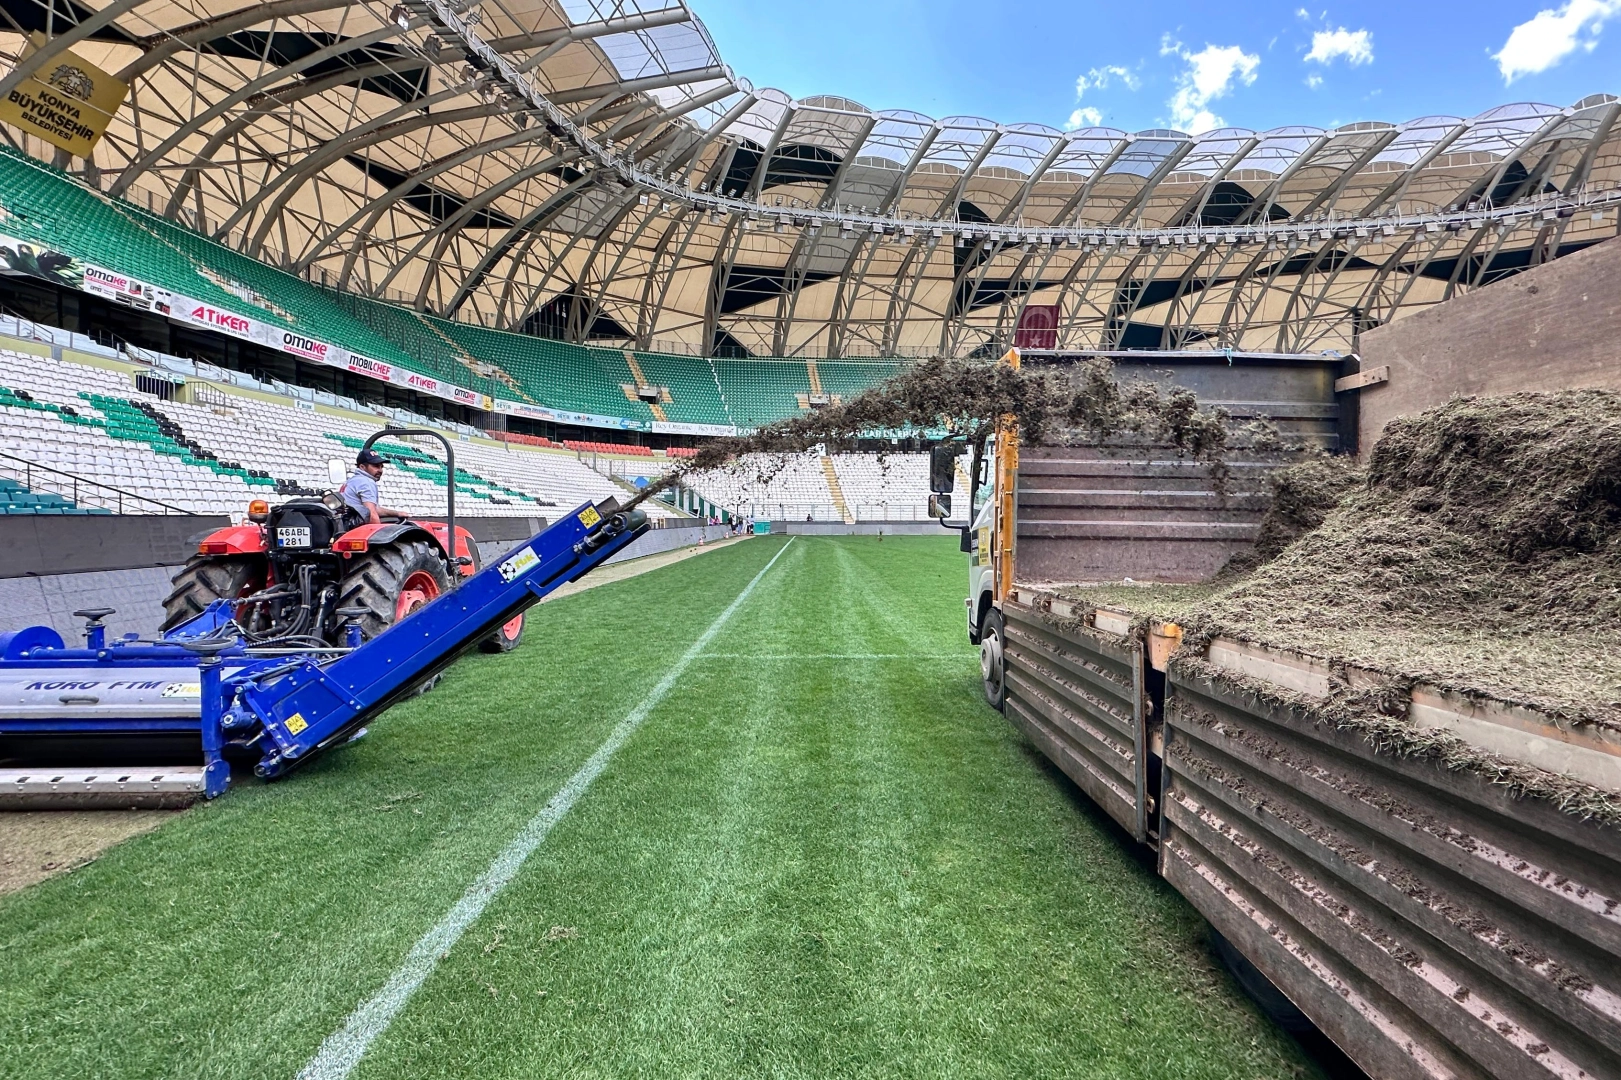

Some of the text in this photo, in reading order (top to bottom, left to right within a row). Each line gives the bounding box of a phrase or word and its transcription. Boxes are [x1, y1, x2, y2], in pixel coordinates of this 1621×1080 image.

[38, 90, 80, 119] KONYA
[8, 90, 95, 141] BÜYÜKŞEHİR
[21, 111, 73, 141] BELEDİYESİ
[86, 267, 127, 287] omake
[283, 333, 328, 355] omake
[279, 528, 309, 537] 46ABL
[285, 537, 302, 546] 281
[24, 681, 163, 690] KORO FTM
